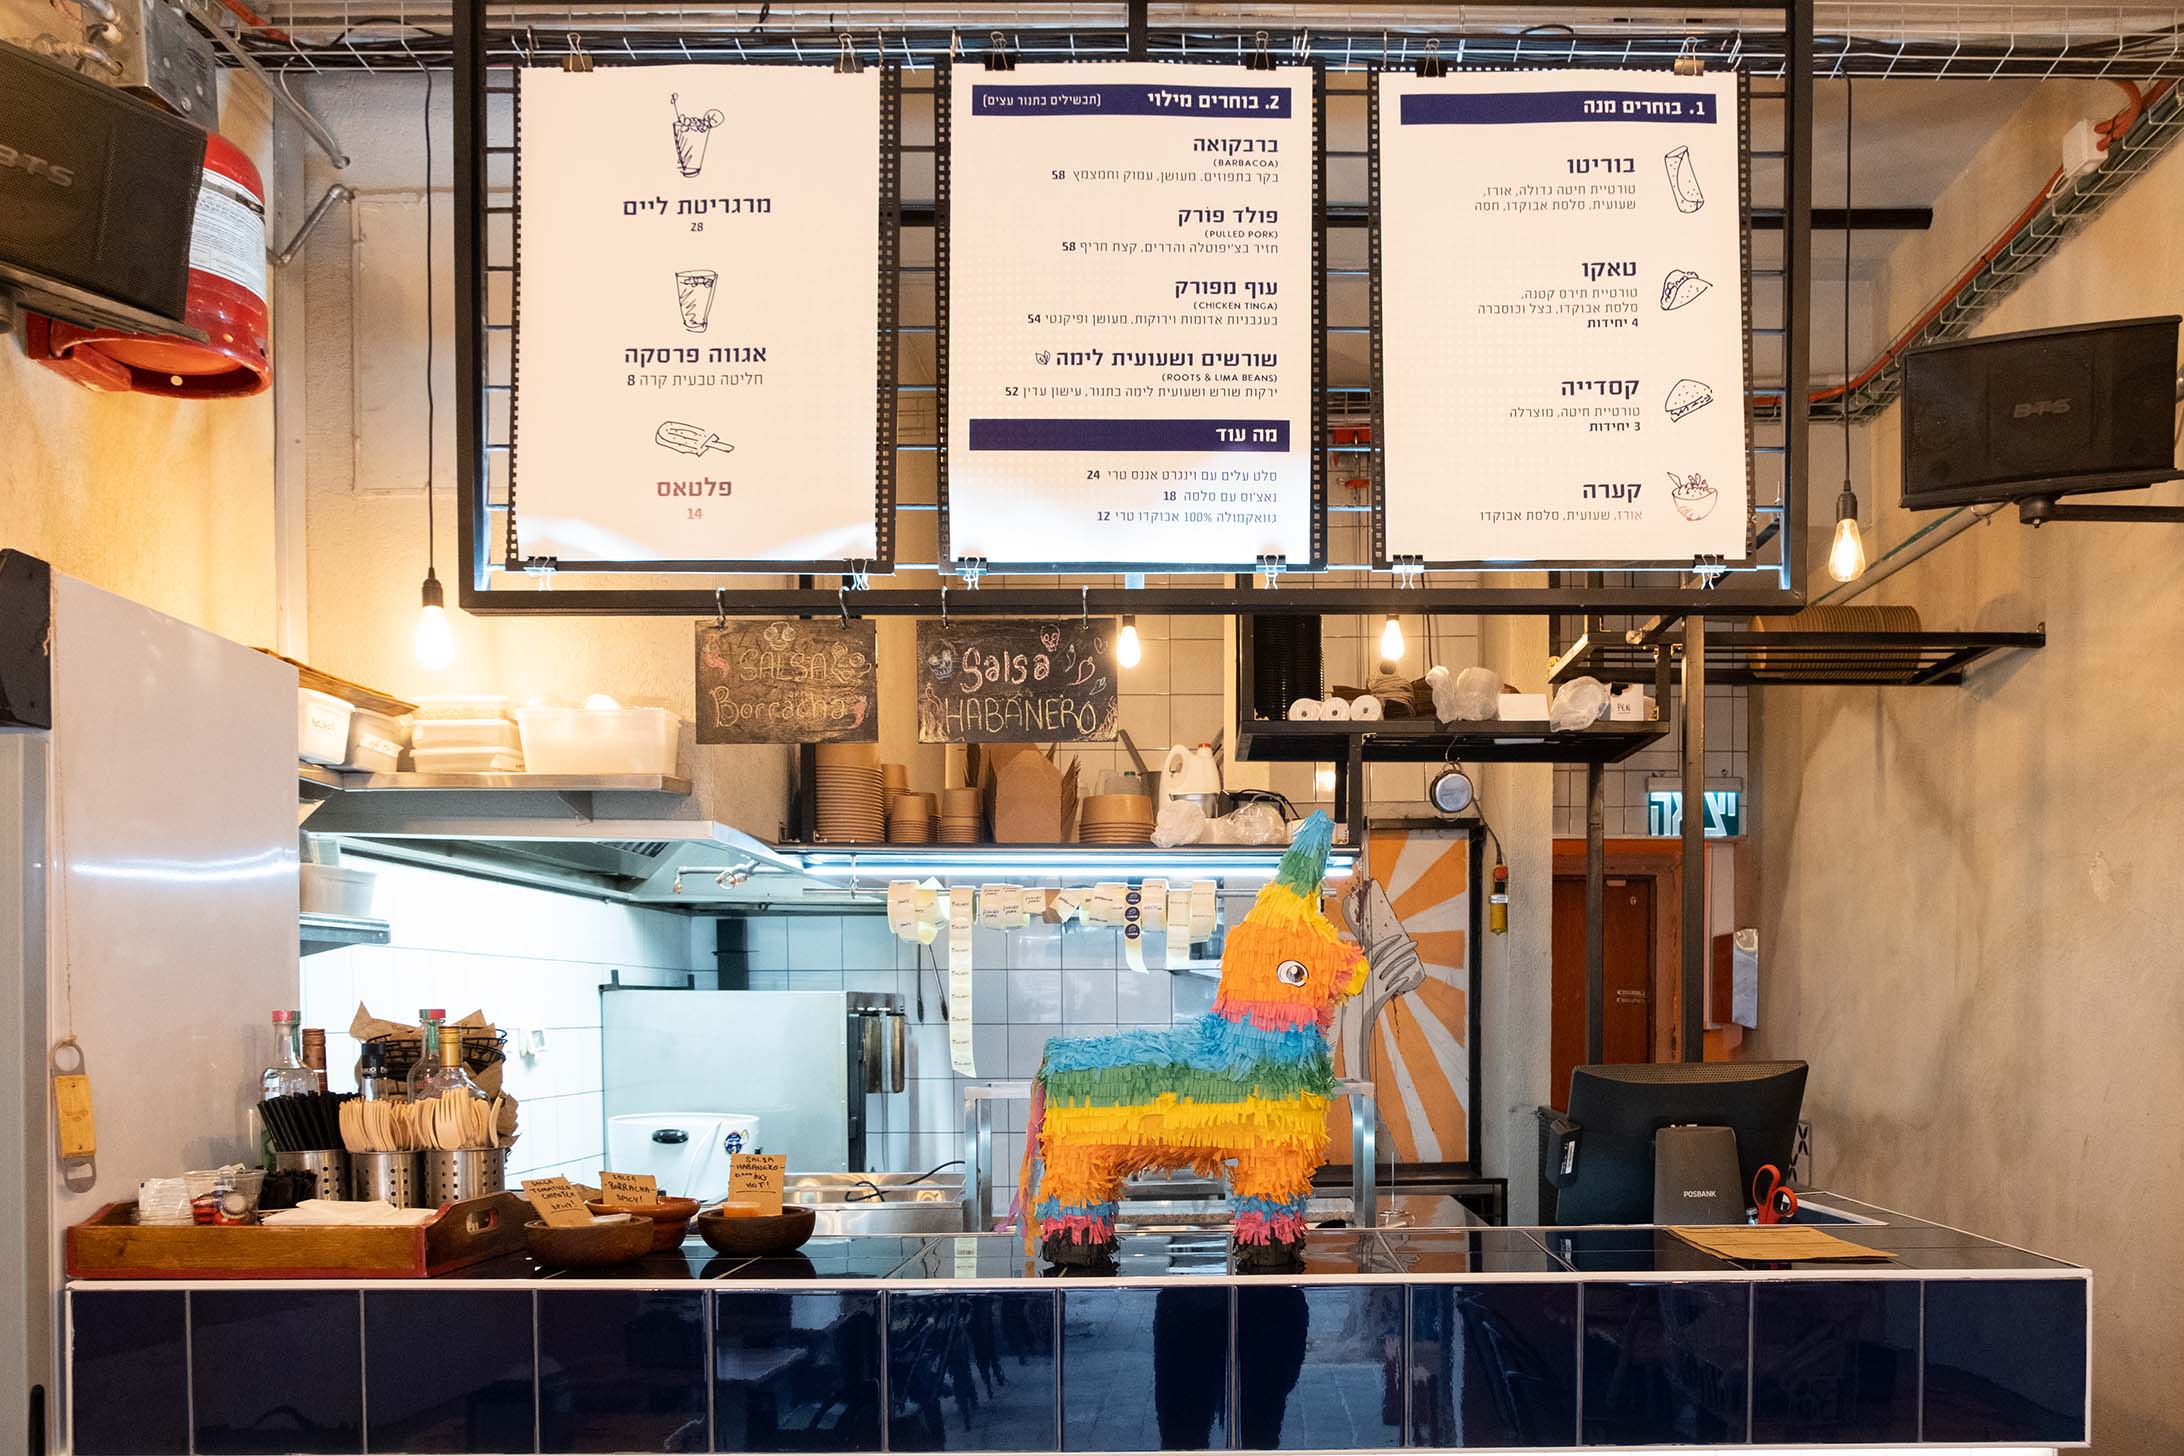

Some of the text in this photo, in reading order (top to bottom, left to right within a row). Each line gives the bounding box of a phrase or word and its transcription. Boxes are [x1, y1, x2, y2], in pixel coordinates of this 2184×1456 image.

[1017, 96, 1047, 106] בתנור
[1147, 90, 1192, 107] מילוי
[1198, 95, 1259, 109] בוחרים
[1265, 95, 1279, 109] 2.
[1584, 100, 1705, 115] 1. בוחרים מנה
[1194, 138, 1278, 156] ברבקואה
[1213, 159, 1278, 168] (BARBACOA)
[1567, 158, 1635, 174] בוריטו
[1052, 170, 1065, 180] 58
[1073, 170, 1119, 182] וחמצמץ
[1124, 171, 1153, 183] עמוק
[1256, 173, 1278, 185] בקר
[1557, 185, 1586, 195] חיטה
[1590, 185, 1635, 195] טורטיית
[623, 196, 771, 215] מרגריטת ליים
[1475, 202, 1499, 211] חסה
[1552, 199, 1585, 210] סלסת
[1233, 206, 1278, 223] פולד
[691, 222, 703, 232] 28
[1062, 241, 1076, 251] 58
[1080, 242, 1107, 254] חריף
[1113, 243, 1137, 255] קצת
[1255, 244, 1278, 253] חזיר
[1582, 262, 1636, 282] טאקו
[1175, 281, 1277, 299] עוף מפורק
[1559, 289, 1587, 299] תירס
[1592, 288, 1638, 298] טורטיית
[1478, 305, 1525, 314] וכוסברה
[1529, 303, 1552, 314] בצל
[1605, 302, 1638, 313] סלסת
[1028, 314, 1041, 324] 54
[1046, 314, 1088, 326] ופיקנטי
[1093, 315, 1127, 326] מעושן
[1181, 315, 1222, 325] אדומות
[1227, 316, 1277, 325] בעגבניות
[1587, 318, 1638, 328] 4 יחידות
[625, 347, 766, 367] אגווה פרסקה
[1057, 348, 1277, 367] שורשים ושעועית לימה
[627, 372, 763, 389] חליטה טבעית קרה 8
[1204, 373, 1211, 382] &
[1005, 386, 1019, 396] 52
[1023, 387, 1046, 399] עדין
[1051, 387, 1081, 399] עישון
[1126, 386, 1153, 397] לימה
[1158, 388, 1205, 397] ושעועית
[1210, 388, 1240, 397] שורש
[1246, 388, 1277, 400] ירקות
[1561, 380, 1639, 400] קסדייה
[1510, 407, 1553, 418] מוצרלה
[1595, 407, 1640, 417] טורטיית
[1589, 422, 1640, 432] 3 יחידות
[1216, 428, 1277, 442] מה עוד
[1087, 470, 1277, 481] סלט עלים עם וינגרט אננס טרי 24
[657, 477, 732, 496] פלטאס
[1164, 491, 1176, 501] 18
[1184, 490, 1216, 501] סלסה
[1221, 492, 1236, 502] עם
[1583, 484, 1642, 503] קערה
[688, 508, 703, 519] 14
[1097, 511, 1276, 525] גוואקמולה 100% אבוקדו טרי 12
[1480, 512, 1521, 524] אבוקדו
[1526, 510, 1559, 521] סלסת
[740, 649, 828, 682] SALSA
[710, 685, 847, 729] Borracha
[1650, 792, 1736, 836] יצאה
[1683, 1190, 1717, 1198] POSBANK
